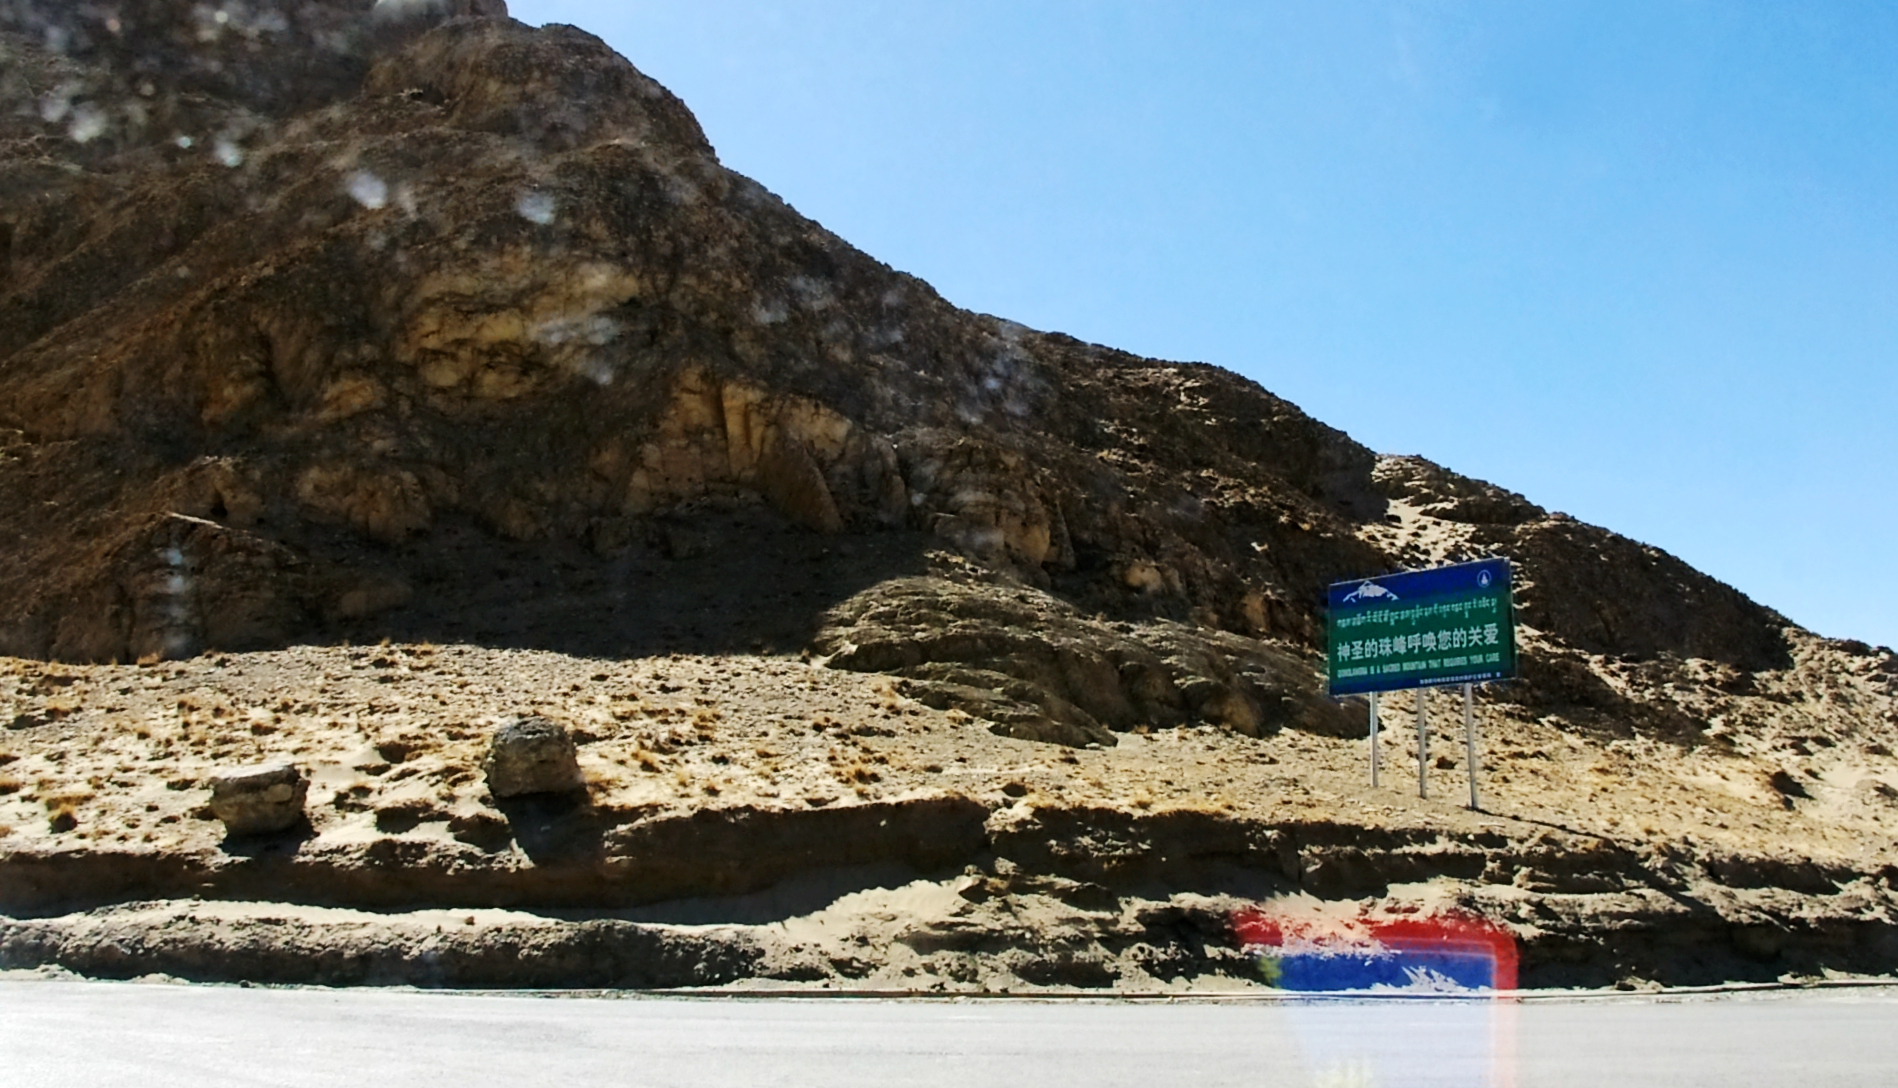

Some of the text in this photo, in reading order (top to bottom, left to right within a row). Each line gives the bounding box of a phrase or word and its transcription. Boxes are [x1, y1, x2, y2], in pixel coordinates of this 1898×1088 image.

[1337, 622, 1498, 662] 神圣的珠峰呼唤您的关爱
